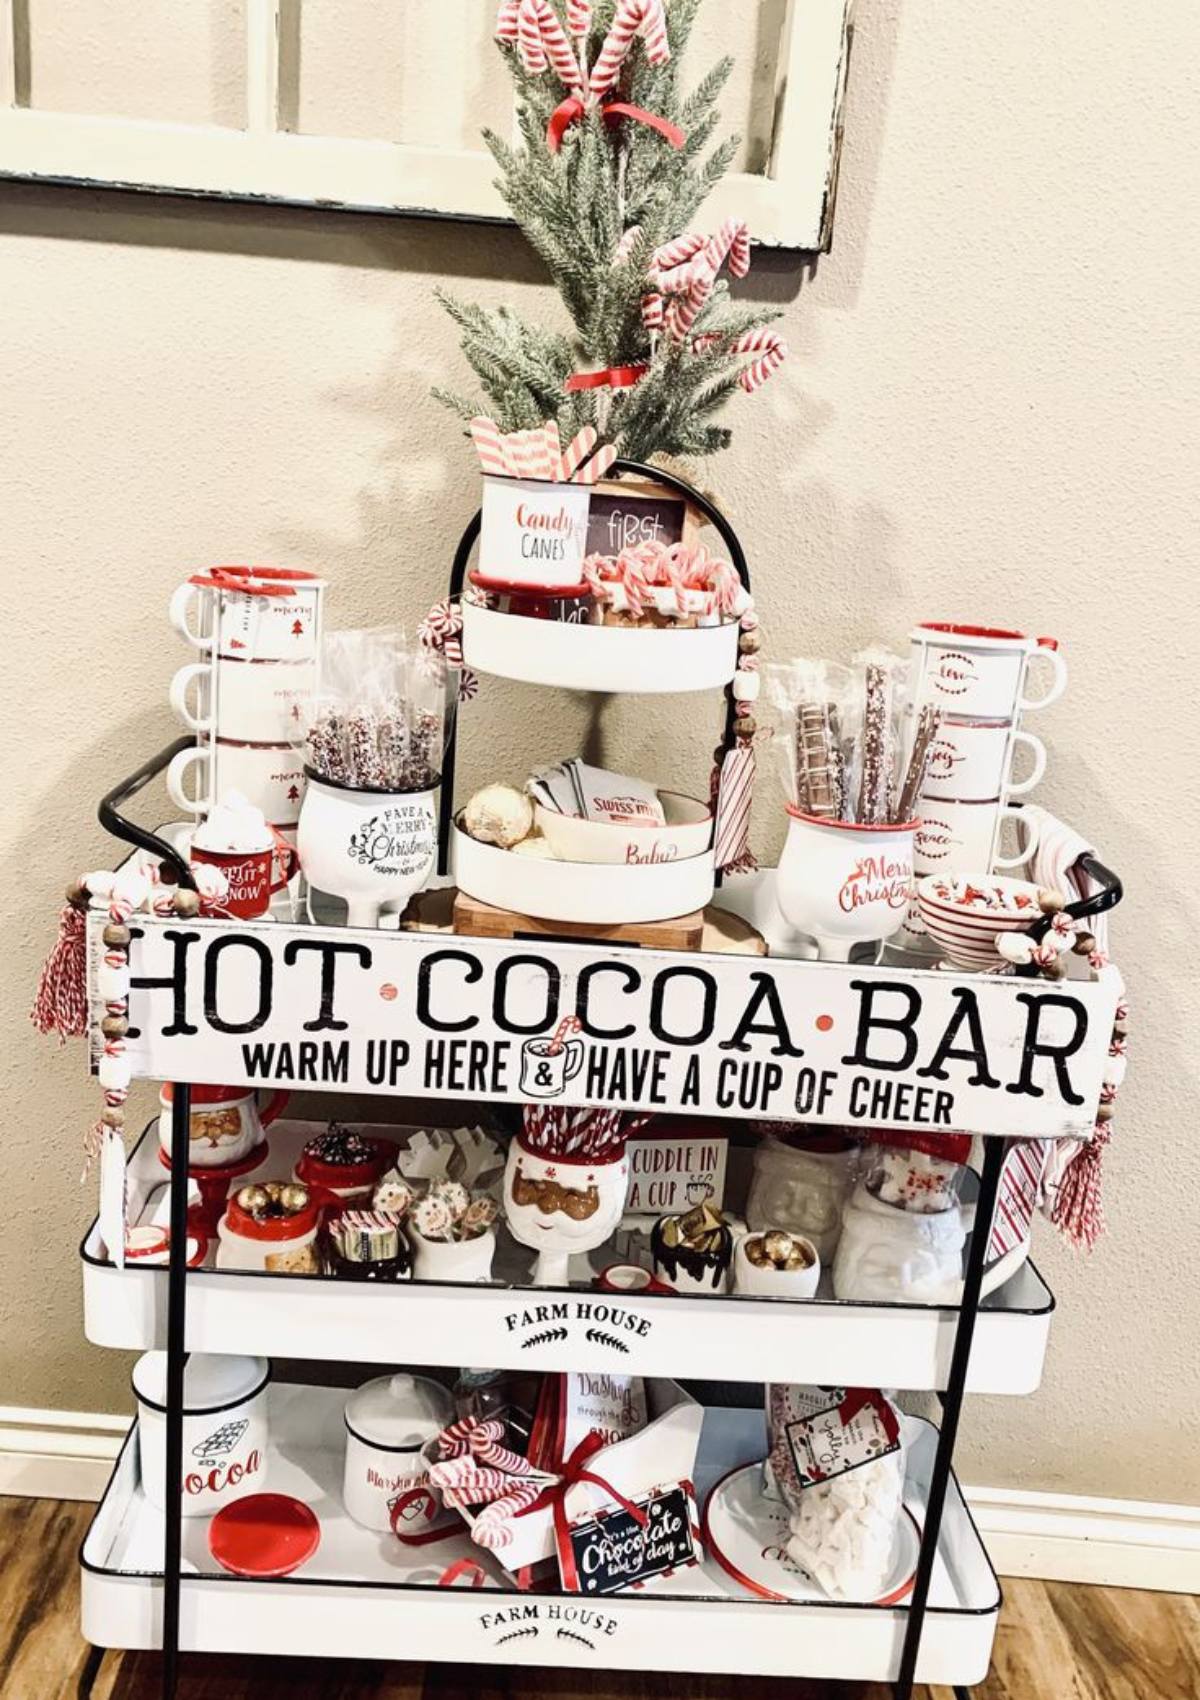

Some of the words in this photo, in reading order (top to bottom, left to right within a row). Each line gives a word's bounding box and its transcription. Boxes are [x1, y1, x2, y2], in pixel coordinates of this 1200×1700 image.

[516, 503, 575, 537] Candy
[521, 533, 565, 560] CANES
[382, 819, 426, 835] ERRY
[839, 880, 918, 912] Christm
[129, 928, 373, 1038] HOT
[416, 949, 804, 1058] COCOA
[841, 980, 1086, 1106] BAR
[243, 1041, 350, 1083] WARM
[366, 1040, 410, 1086] UP
[424, 1041, 511, 1094] HERE
[534, 1061, 553, 1087] &
[586, 1043, 672, 1104] HAVE
[680, 1051, 700, 1106] A
[716, 1058, 783, 1110] CUP
[797, 1066, 838, 1114] OF
[849, 1075, 955, 1124] CHEER
[632, 1146, 694, 1174] CUDDLE
[701, 1145, 719, 1171] IN
[629, 1182, 640, 1208] A
[648, 1181, 678, 1206] CUP
[504, 1303, 569, 1331] FARM
[575, 1303, 652, 1337] HOUSE
[184, 1449, 263, 1496] ocoa
[582, 1512, 682, 1574] Chocolate
[647, 1542, 677, 1561] day
[480, 1605, 539, 1629] FARM
[548, 1605, 619, 1636] HOUSE
